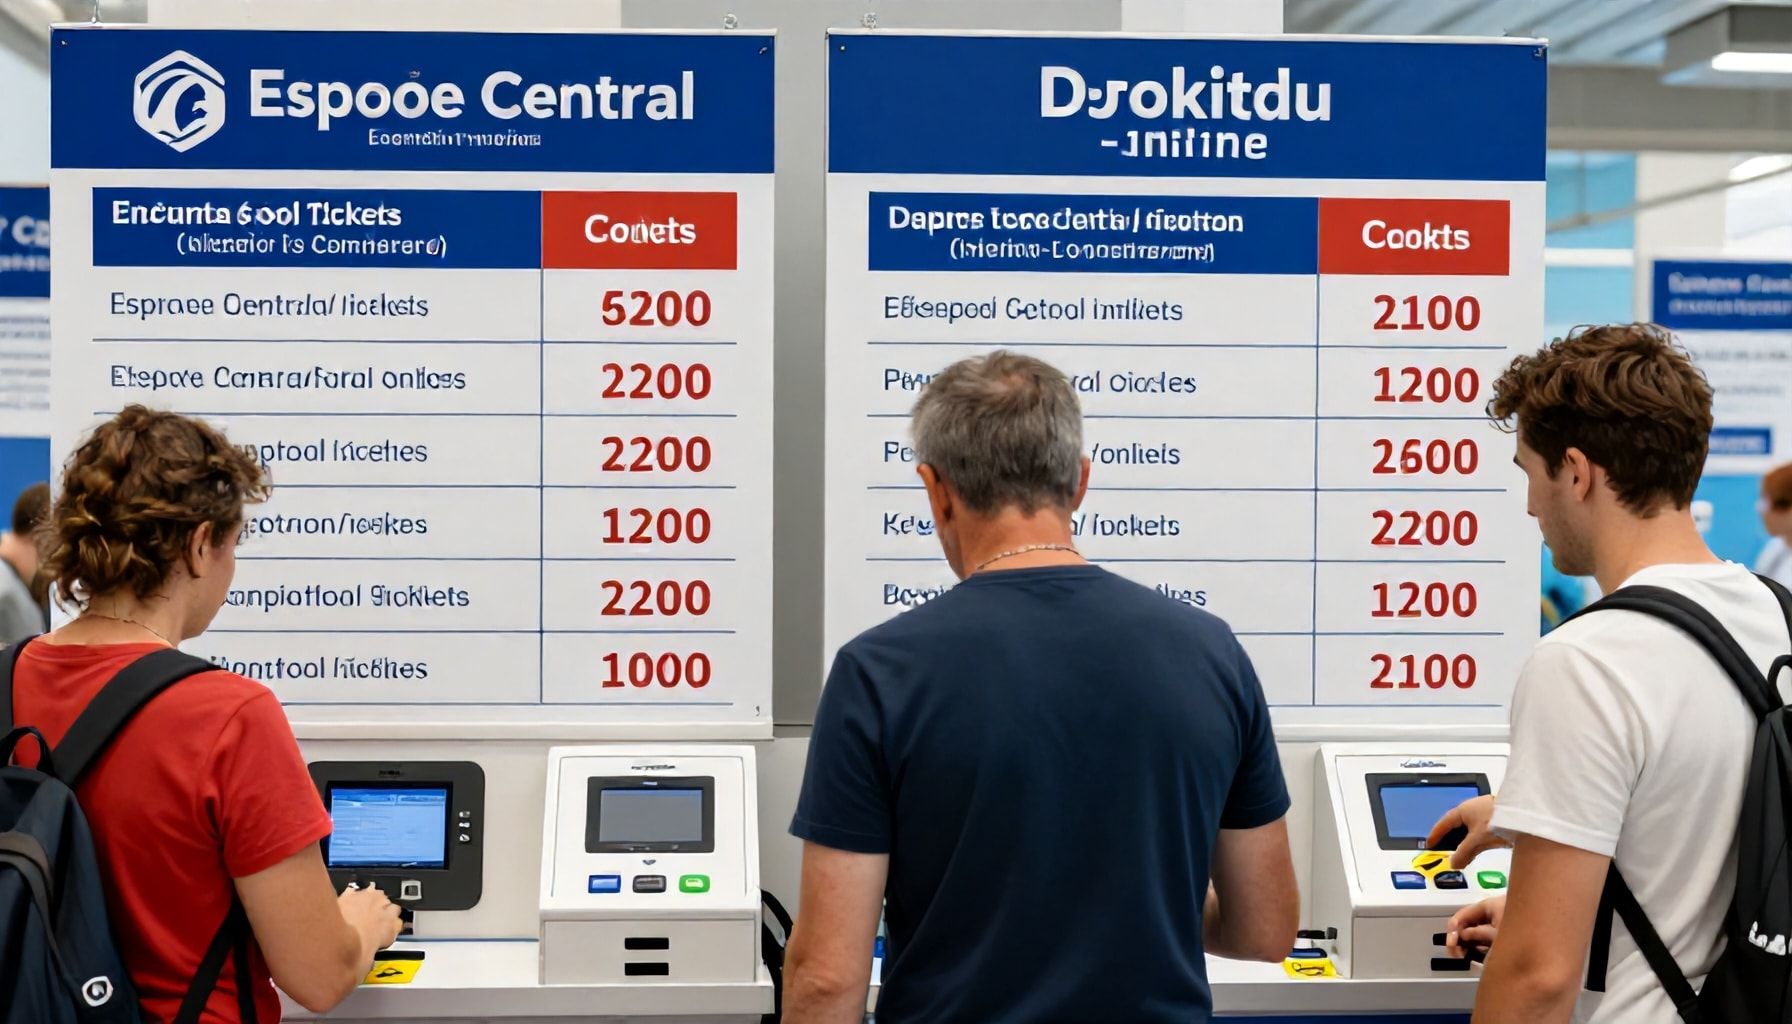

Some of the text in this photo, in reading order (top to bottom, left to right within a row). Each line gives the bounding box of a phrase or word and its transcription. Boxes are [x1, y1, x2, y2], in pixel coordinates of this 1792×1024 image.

[481, 70, 694, 120] Central
[306, 201, 402, 226] Tickets
[602, 289, 712, 327] 5200
[1374, 294, 1481, 332] 2100
[601, 362, 712, 400] 2200
[1374, 366, 1480, 404] 1200
[601, 435, 712, 473] 2200
[1372, 438, 1479, 475] 2600
[602, 507, 711, 545] 1200
[1371, 509, 1479, 547] 2200
[600, 579, 711, 617] 2200
[1371, 581, 1477, 618] 1200
[602, 651, 711, 689] 1000
[1370, 653, 1477, 690] 2100
